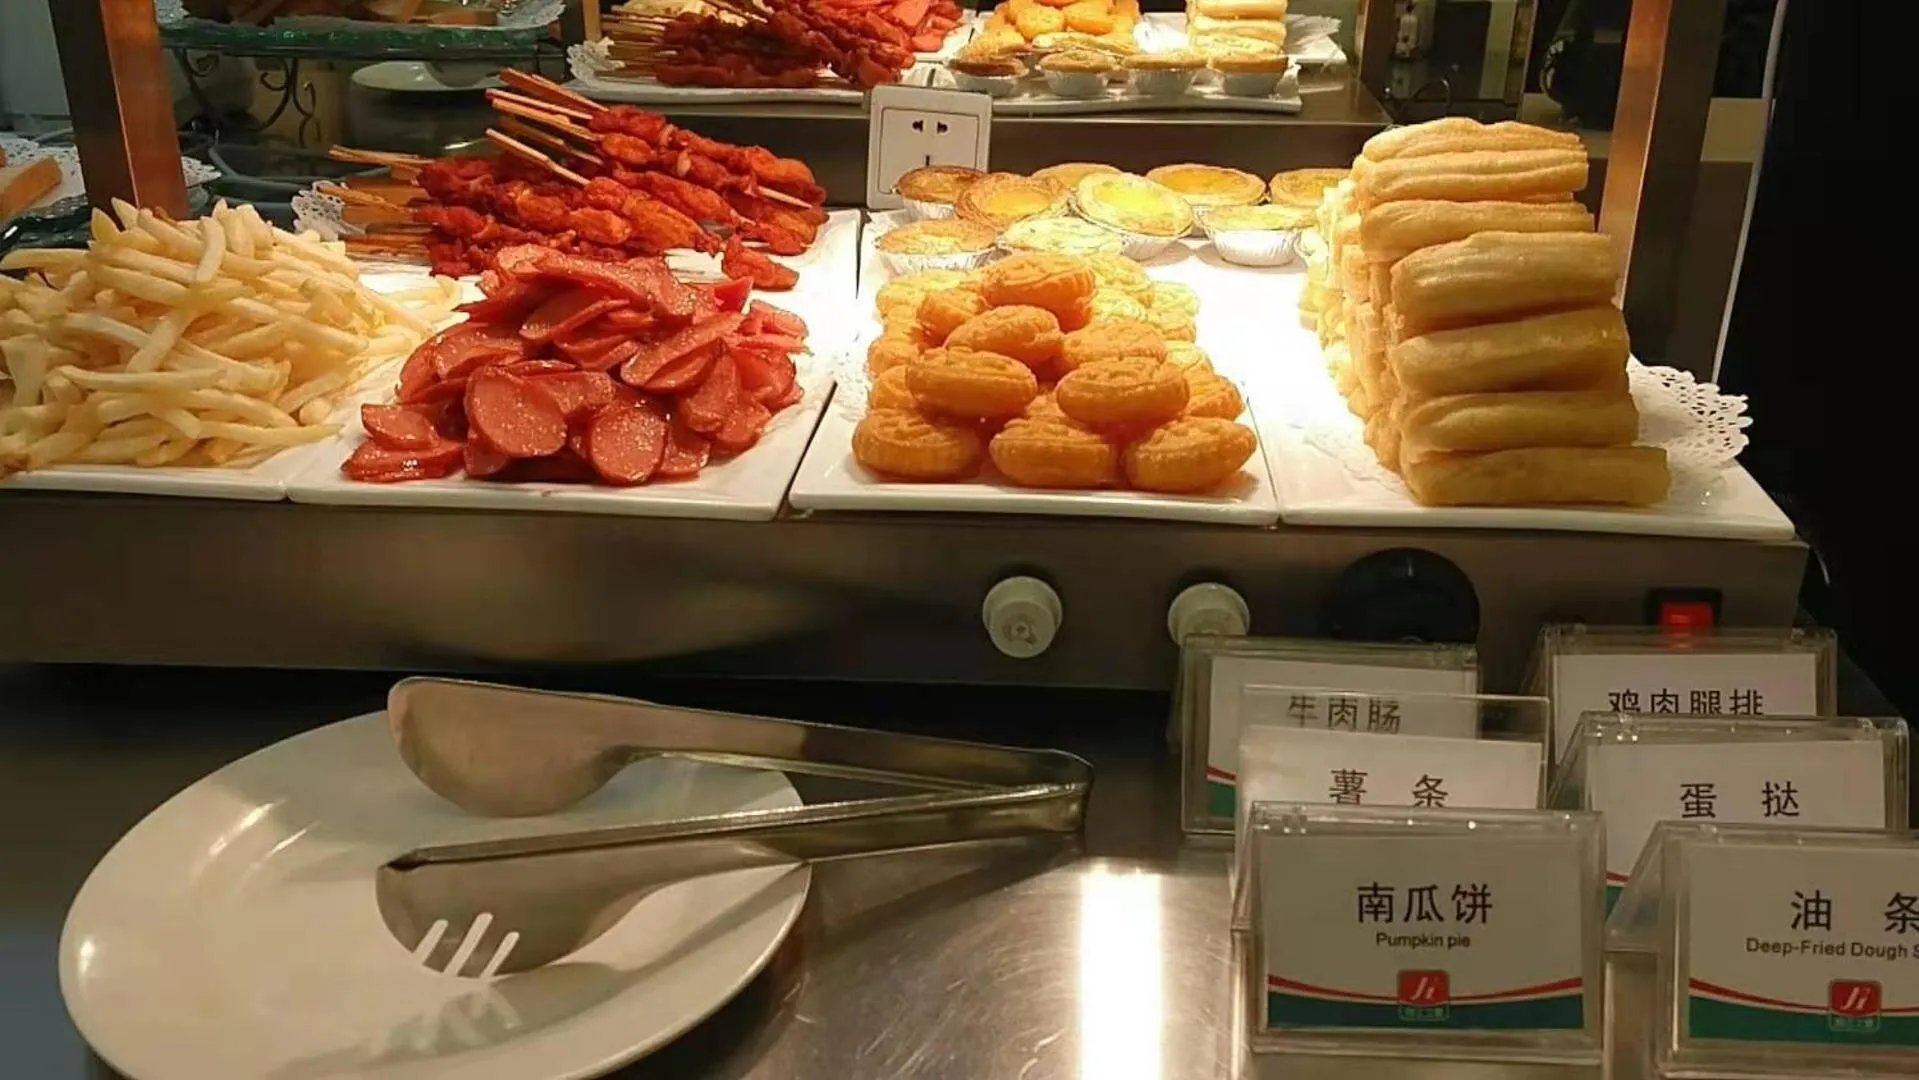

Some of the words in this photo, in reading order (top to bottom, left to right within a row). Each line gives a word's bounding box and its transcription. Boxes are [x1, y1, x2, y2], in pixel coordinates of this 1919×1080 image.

[1285, 695, 1401, 735] 牛肉肠
[1607, 688, 1763, 716] 鸡肉腿排
[1328, 768, 1448, 808] 薯条
[1679, 780, 1800, 819] 蛋挞
[1356, 881, 1493, 925] 南瓜饼
[1790, 889, 1919, 934] 油条
[1375, 931, 1444, 949] Pumpkin
[1447, 934, 1471, 950] pie
[1745, 937, 1846, 957] Deep-Fried
[1850, 942, 1908, 961] Dough
